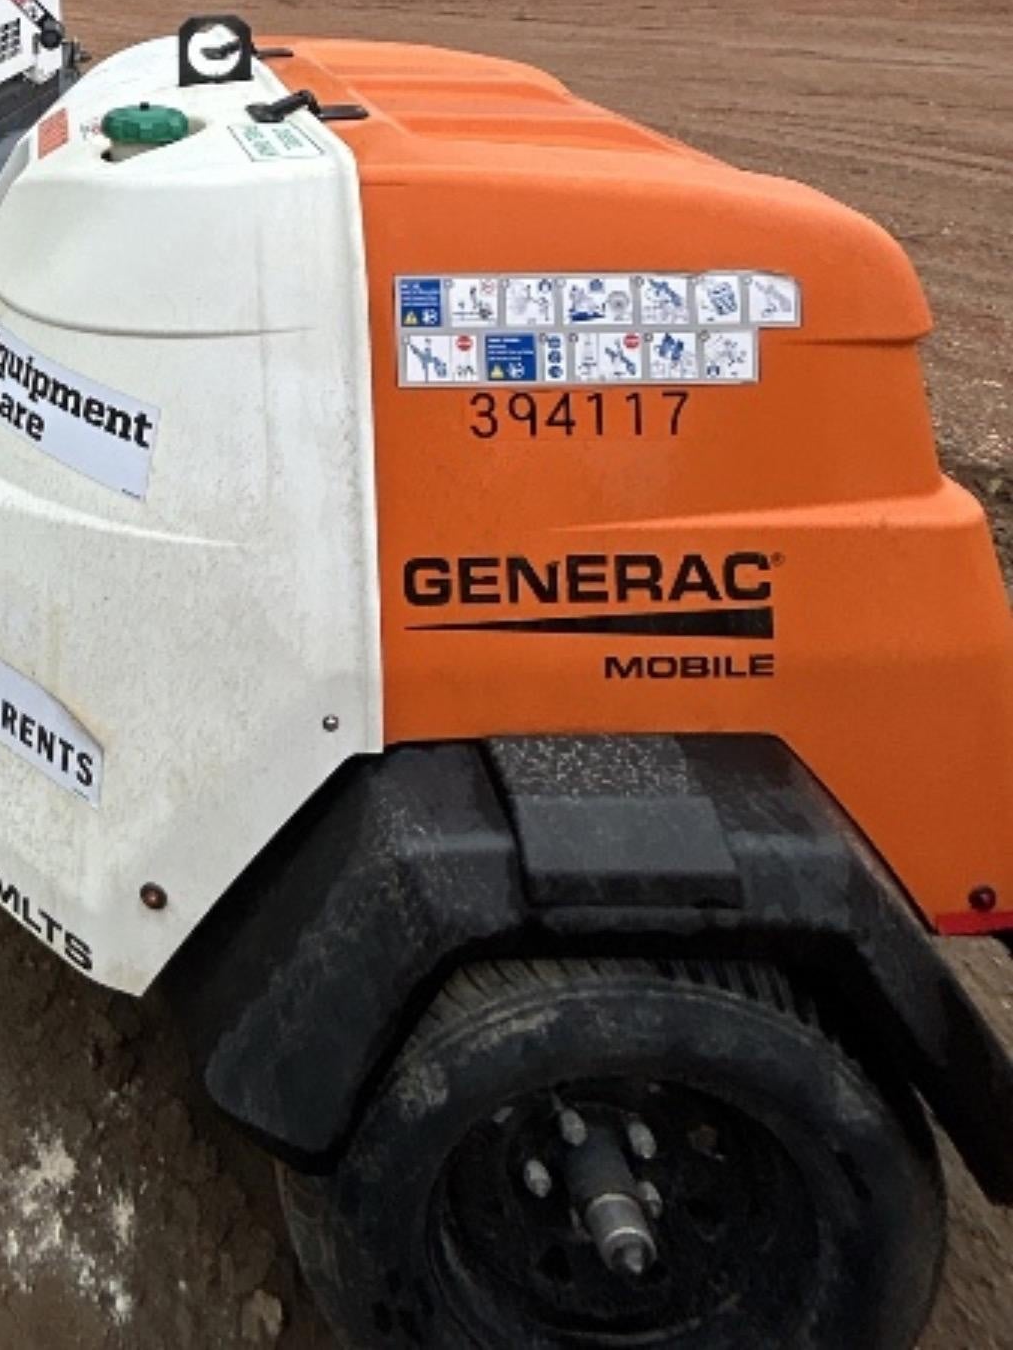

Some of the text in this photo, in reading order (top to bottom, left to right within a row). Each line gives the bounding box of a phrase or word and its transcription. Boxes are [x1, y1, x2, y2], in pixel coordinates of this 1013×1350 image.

[470, 391, 689, 438] 394117
[403, 552, 772, 607] GENERAC
[604, 654, 774, 679] MOBILE
